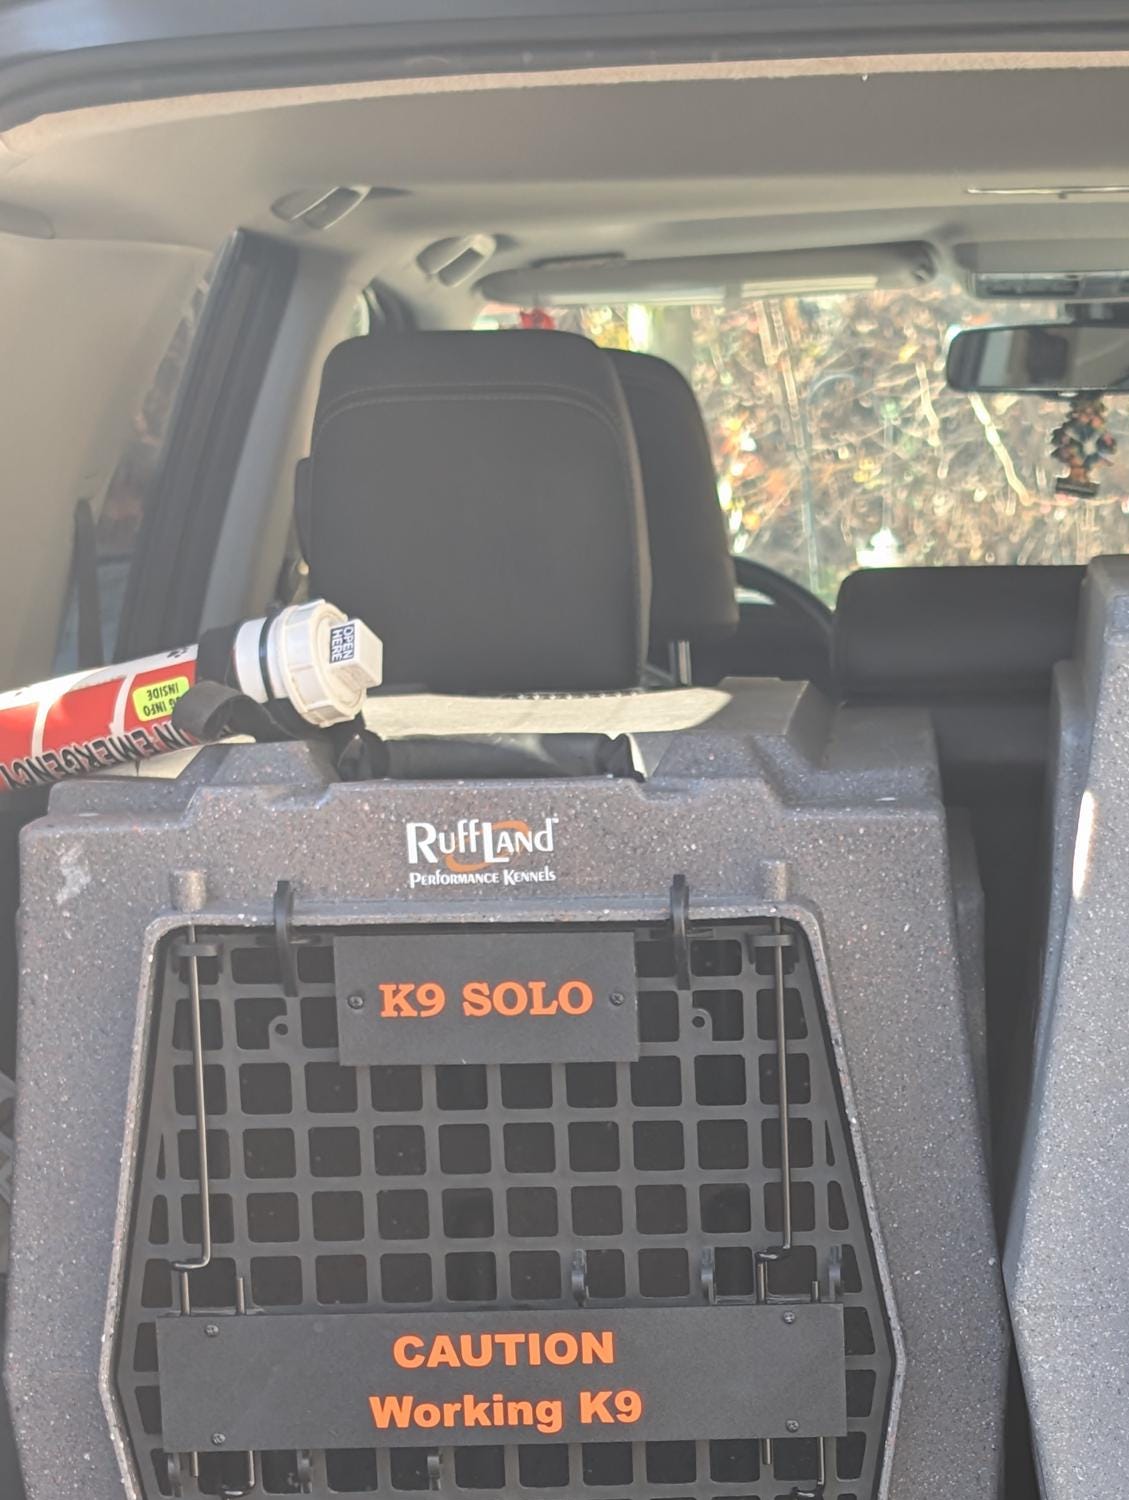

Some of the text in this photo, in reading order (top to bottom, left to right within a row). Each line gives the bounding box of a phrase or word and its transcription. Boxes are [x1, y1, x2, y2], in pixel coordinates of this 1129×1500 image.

[331, 628, 343, 663] HERE
[343, 626, 354, 660] OPEN
[143, 700, 167, 717] INFO
[146, 682, 179, 701] INSIDE
[378, 980, 594, 1018] K9 SOLO
[393, 1331, 614, 1368] CAUTION
[369, 1390, 643, 1434] Working K9
